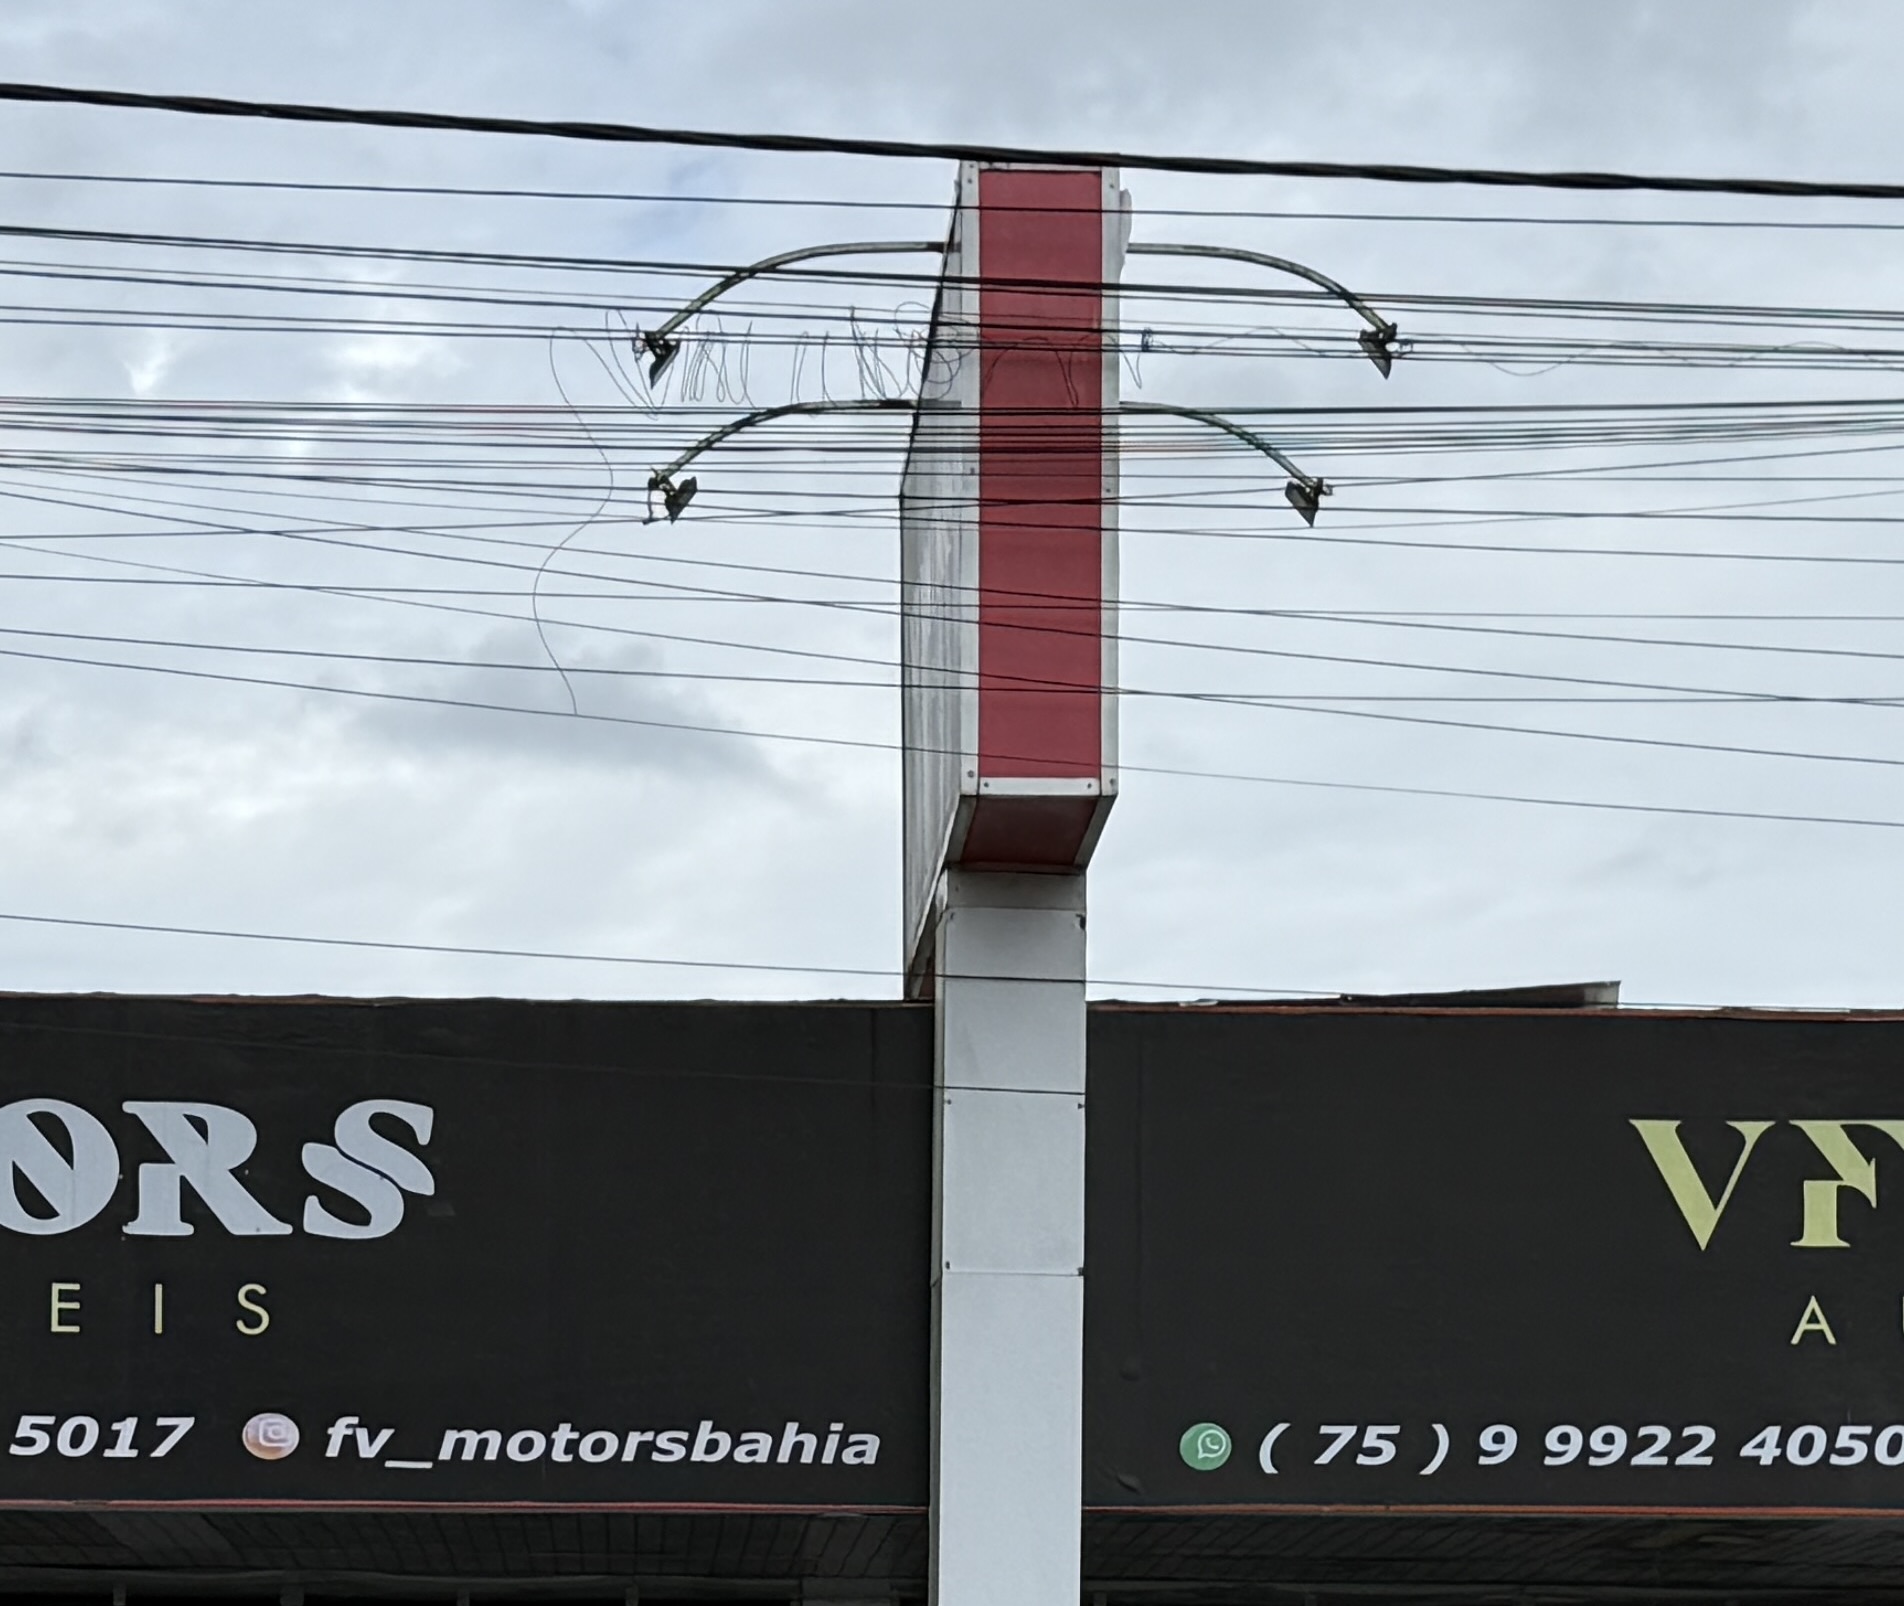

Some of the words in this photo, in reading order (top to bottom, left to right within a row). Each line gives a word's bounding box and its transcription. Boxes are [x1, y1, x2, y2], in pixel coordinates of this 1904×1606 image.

[9, 1415, 195, 1458] 5017
[325, 1416, 881, 1469] fv_motorsbahia
[1478, 1424, 1518, 1465] 9
[1543, 1424, 1716, 1467] 9922
